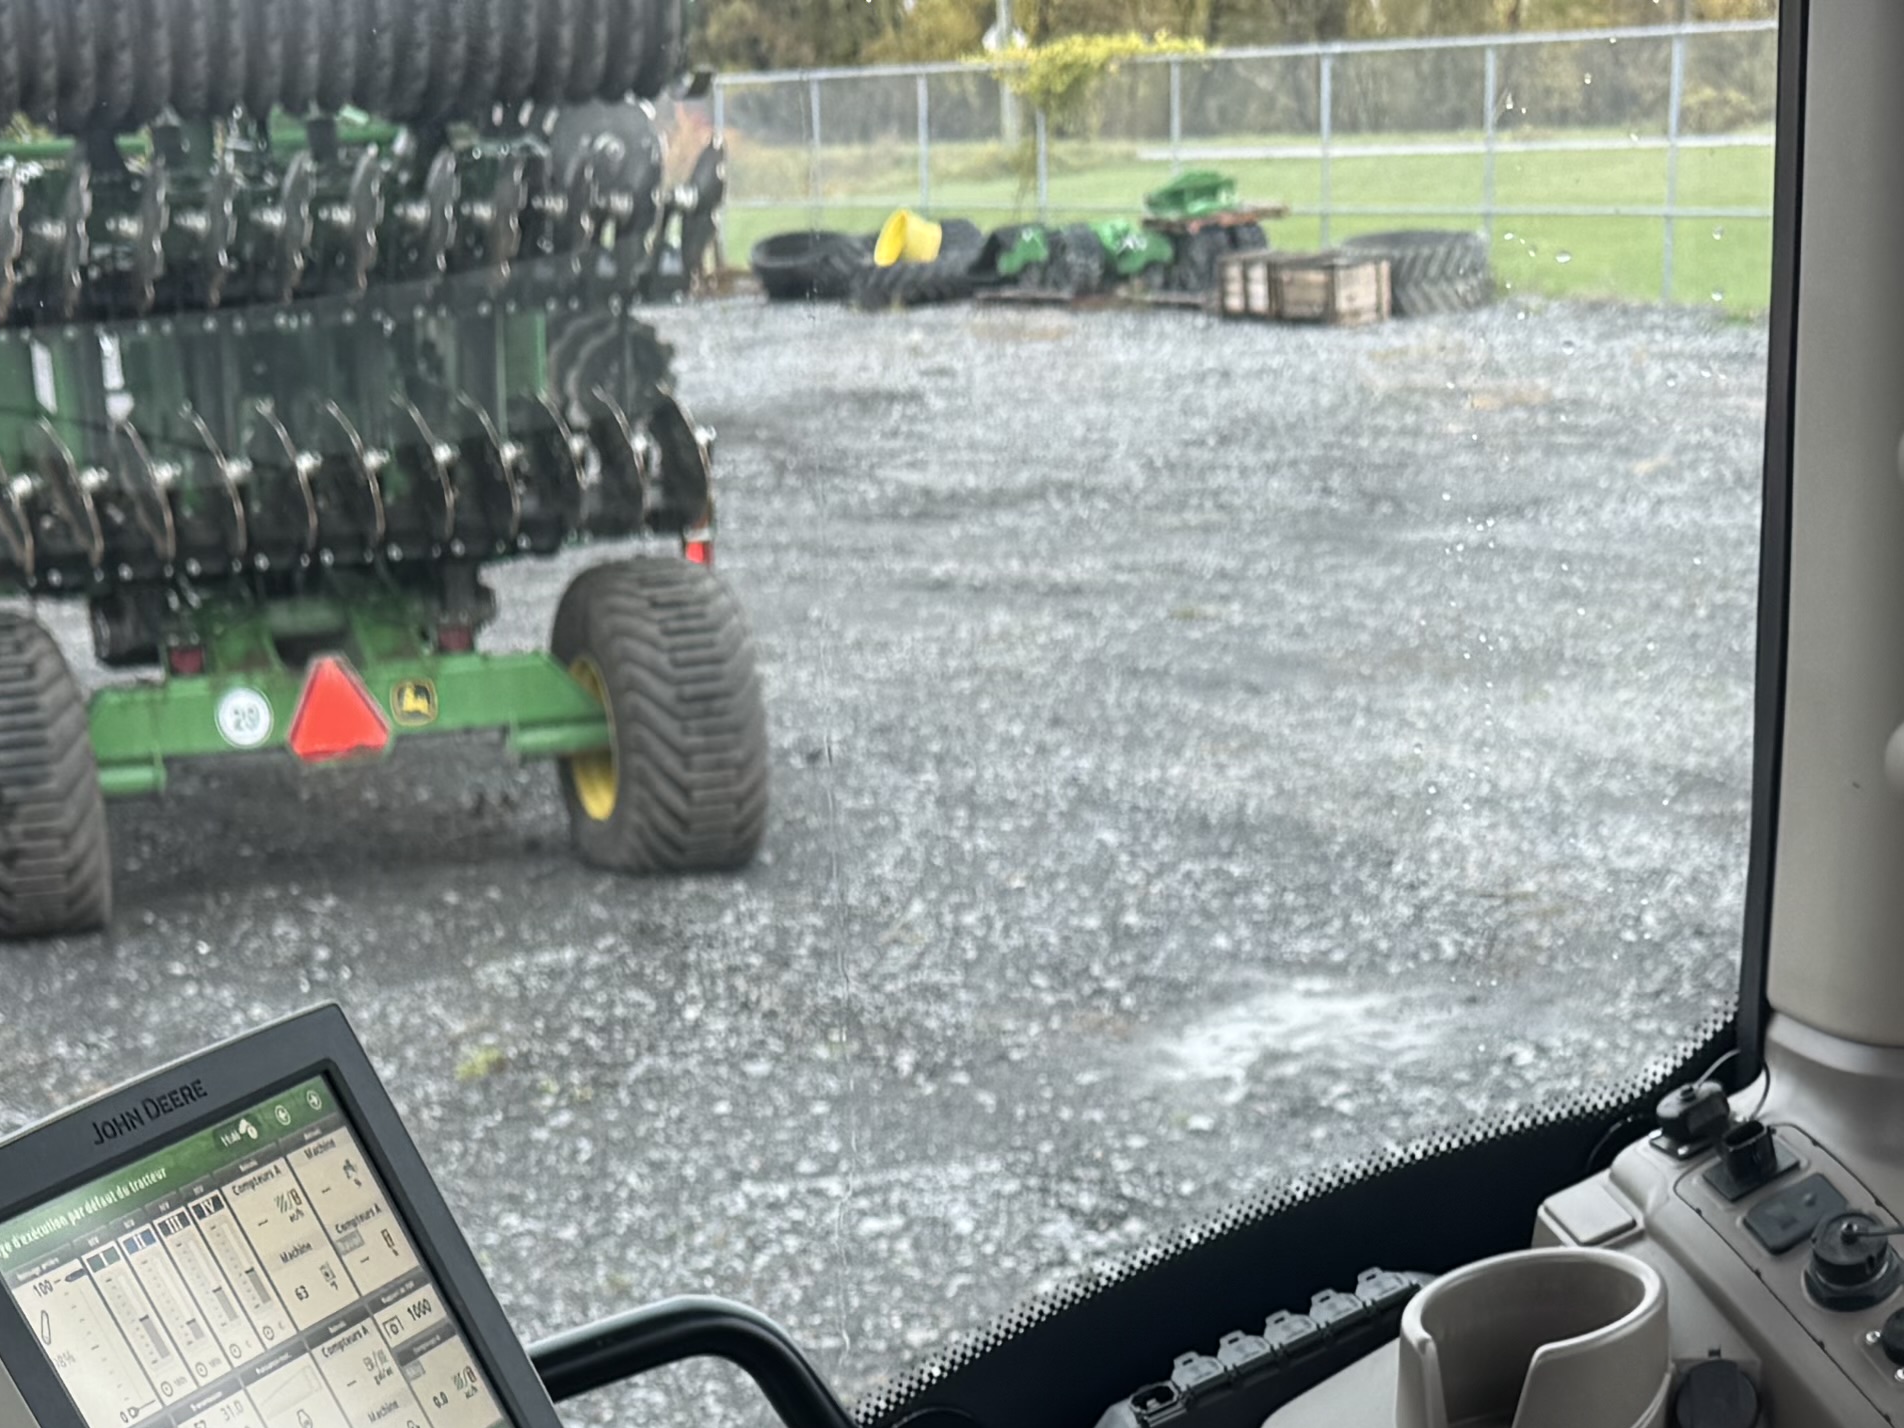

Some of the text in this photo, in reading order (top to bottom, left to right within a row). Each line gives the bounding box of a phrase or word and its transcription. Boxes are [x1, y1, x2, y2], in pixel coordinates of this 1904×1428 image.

[92, 1079, 208, 1145] JOHN DEERE
[66, 1206, 84, 1225] par
[84, 1190, 117, 1213] défaut
[115, 1184, 130, 1198] du
[128, 1167, 166, 1192] tracteur
[32, 1279, 53, 1297] 100
